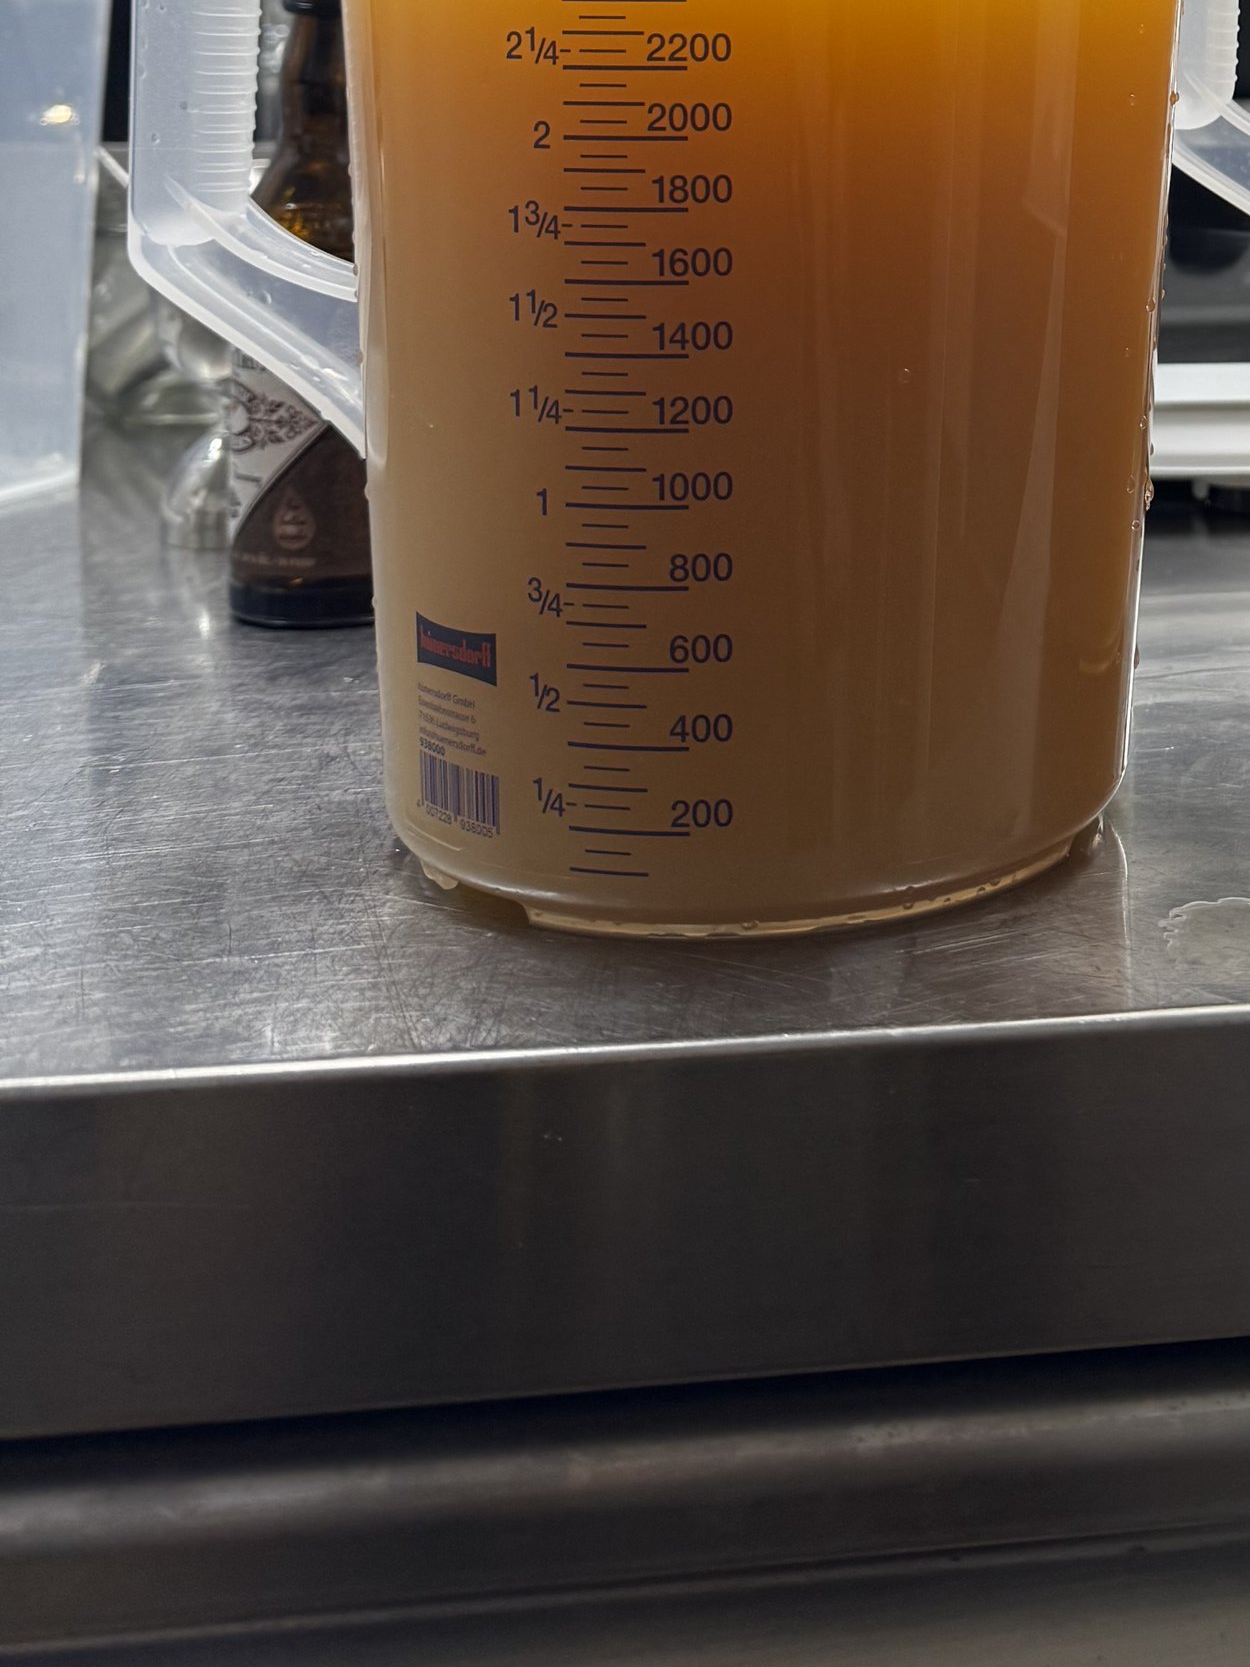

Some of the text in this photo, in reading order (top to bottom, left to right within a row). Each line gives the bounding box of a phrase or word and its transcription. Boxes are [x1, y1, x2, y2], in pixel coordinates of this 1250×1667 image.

[646, 33, 732, 62] 2200
[647, 103, 732, 132] 2000
[533, 120, 551, 149] 2
[652, 174, 733, 204] 1800
[652, 247, 733, 277] 1600
[652, 321, 734, 351] 1400
[652, 395, 733, 425] 1200
[652, 472, 733, 502] 1000
[536, 488, 548, 516] 1
[669, 553, 733, 582] 800
[669, 634, 733, 664] 600
[669, 714, 733, 743] 400
[671, 799, 733, 828] 200
